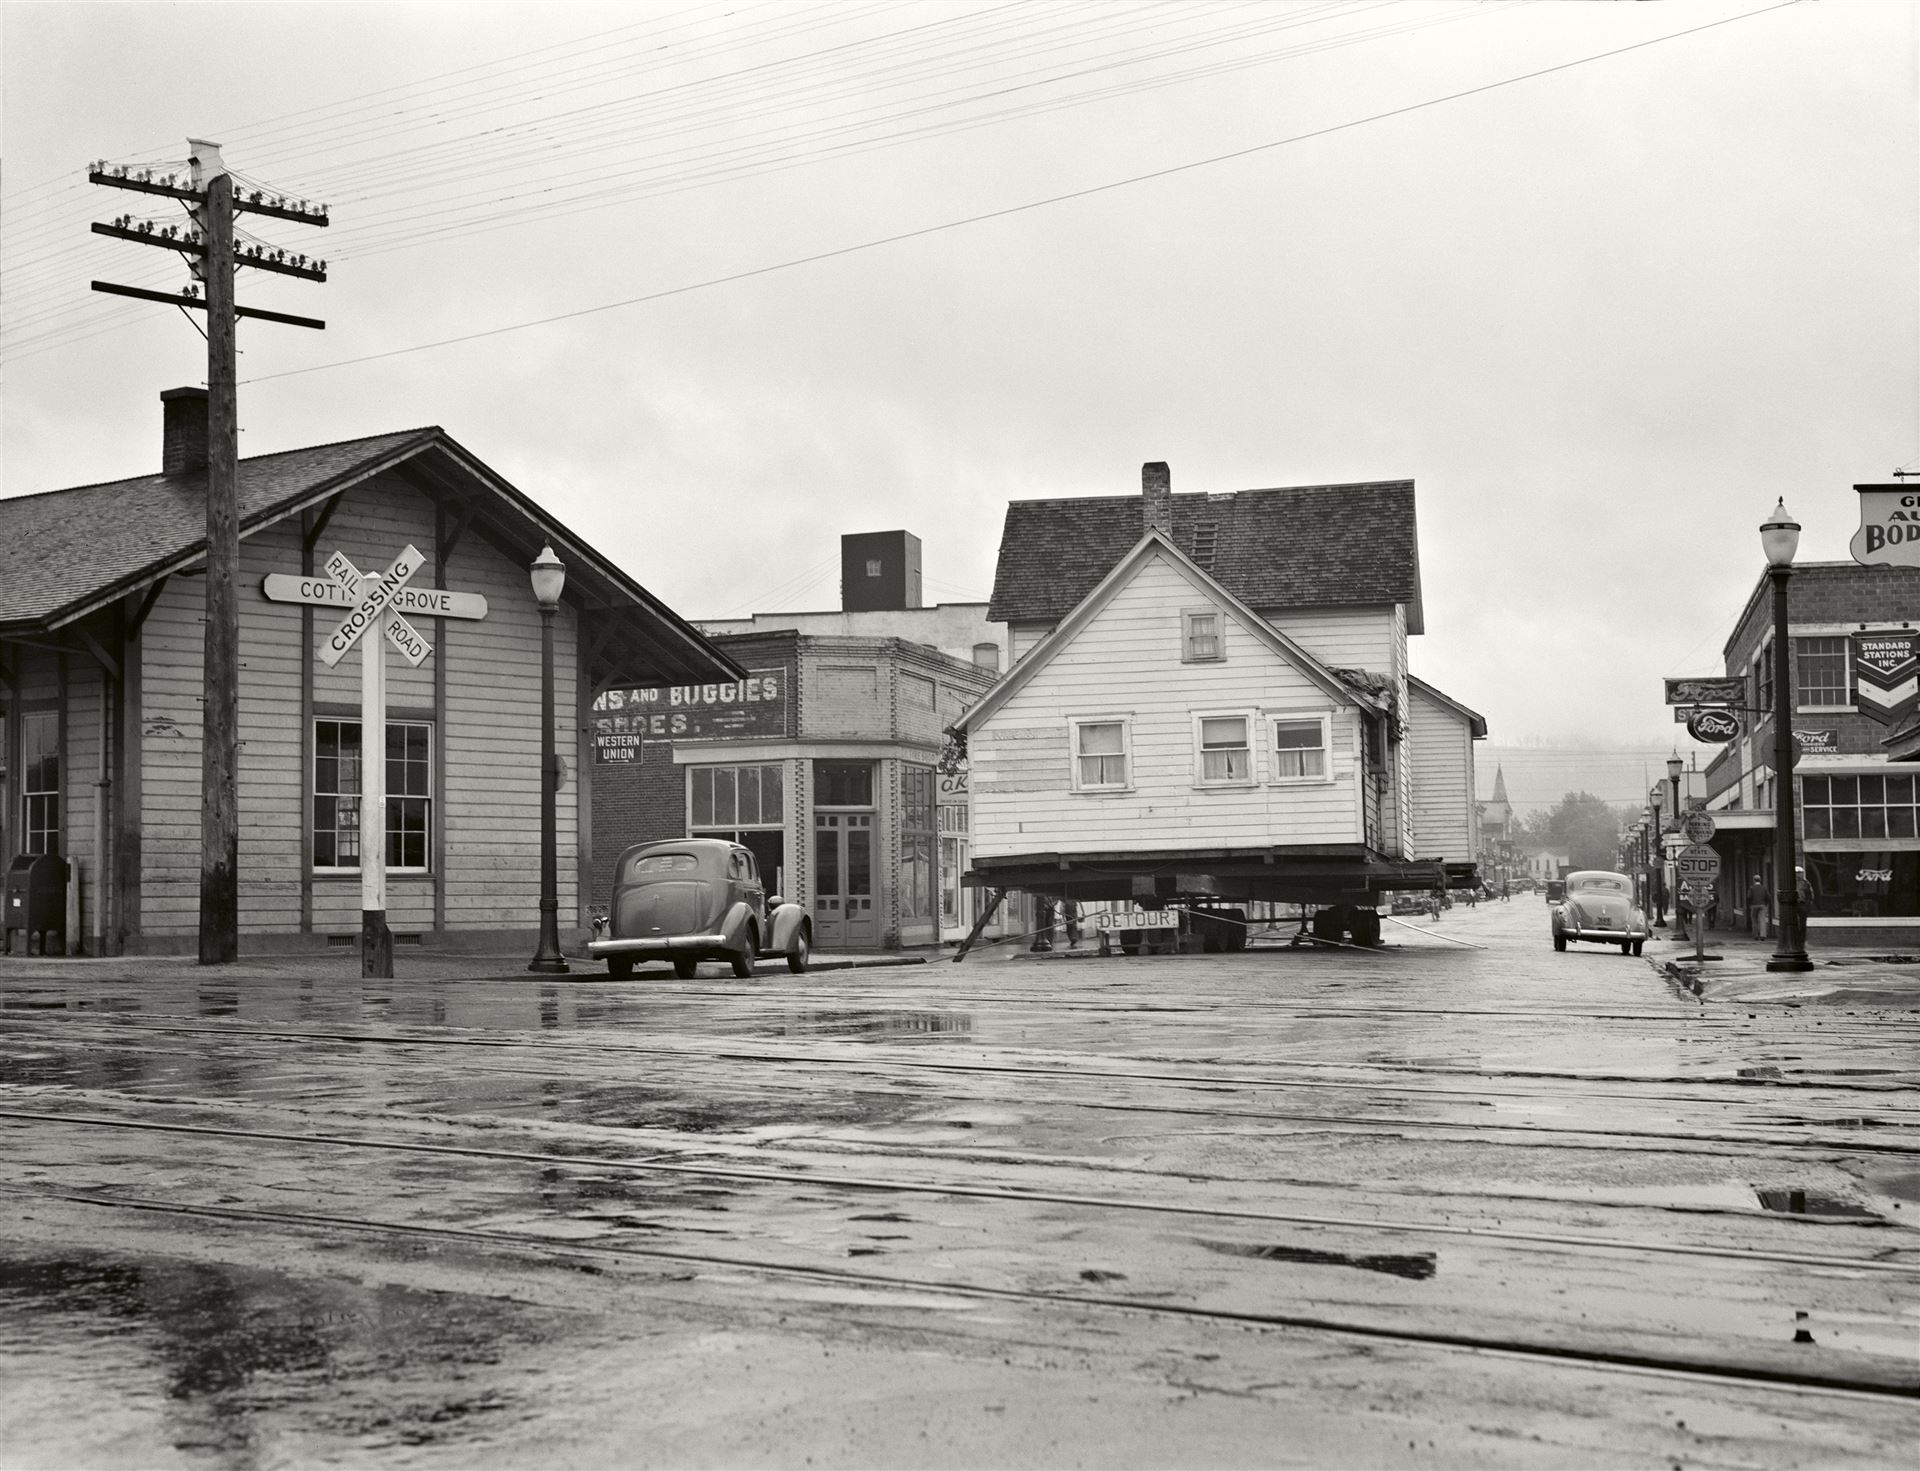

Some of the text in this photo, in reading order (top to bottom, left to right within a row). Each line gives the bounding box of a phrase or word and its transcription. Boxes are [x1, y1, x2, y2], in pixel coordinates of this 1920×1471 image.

[1900, 496, 1920, 507] G
[328, 558, 422, 658] RAIL ROAD
[332, 562, 409, 651] CROSSING
[392, 592, 450, 611] GROVE
[1862, 642, 1911, 651] STANDARD
[1864, 650, 1909, 659] STATIONS
[630, 688, 658, 703] AND
[670, 677, 777, 706] BUGGIES
[1670, 682, 1744, 701] Ford
[1698, 716, 1735, 735] Ford
[597, 735, 640, 747] WESTERN
[1792, 730, 1829, 742] Ford
[603, 749, 635, 760] UNION
[1680, 859, 1718, 872] STOP
[1855, 868, 1893, 881] Ford
[1100, 911, 1170, 928] DETOUR
